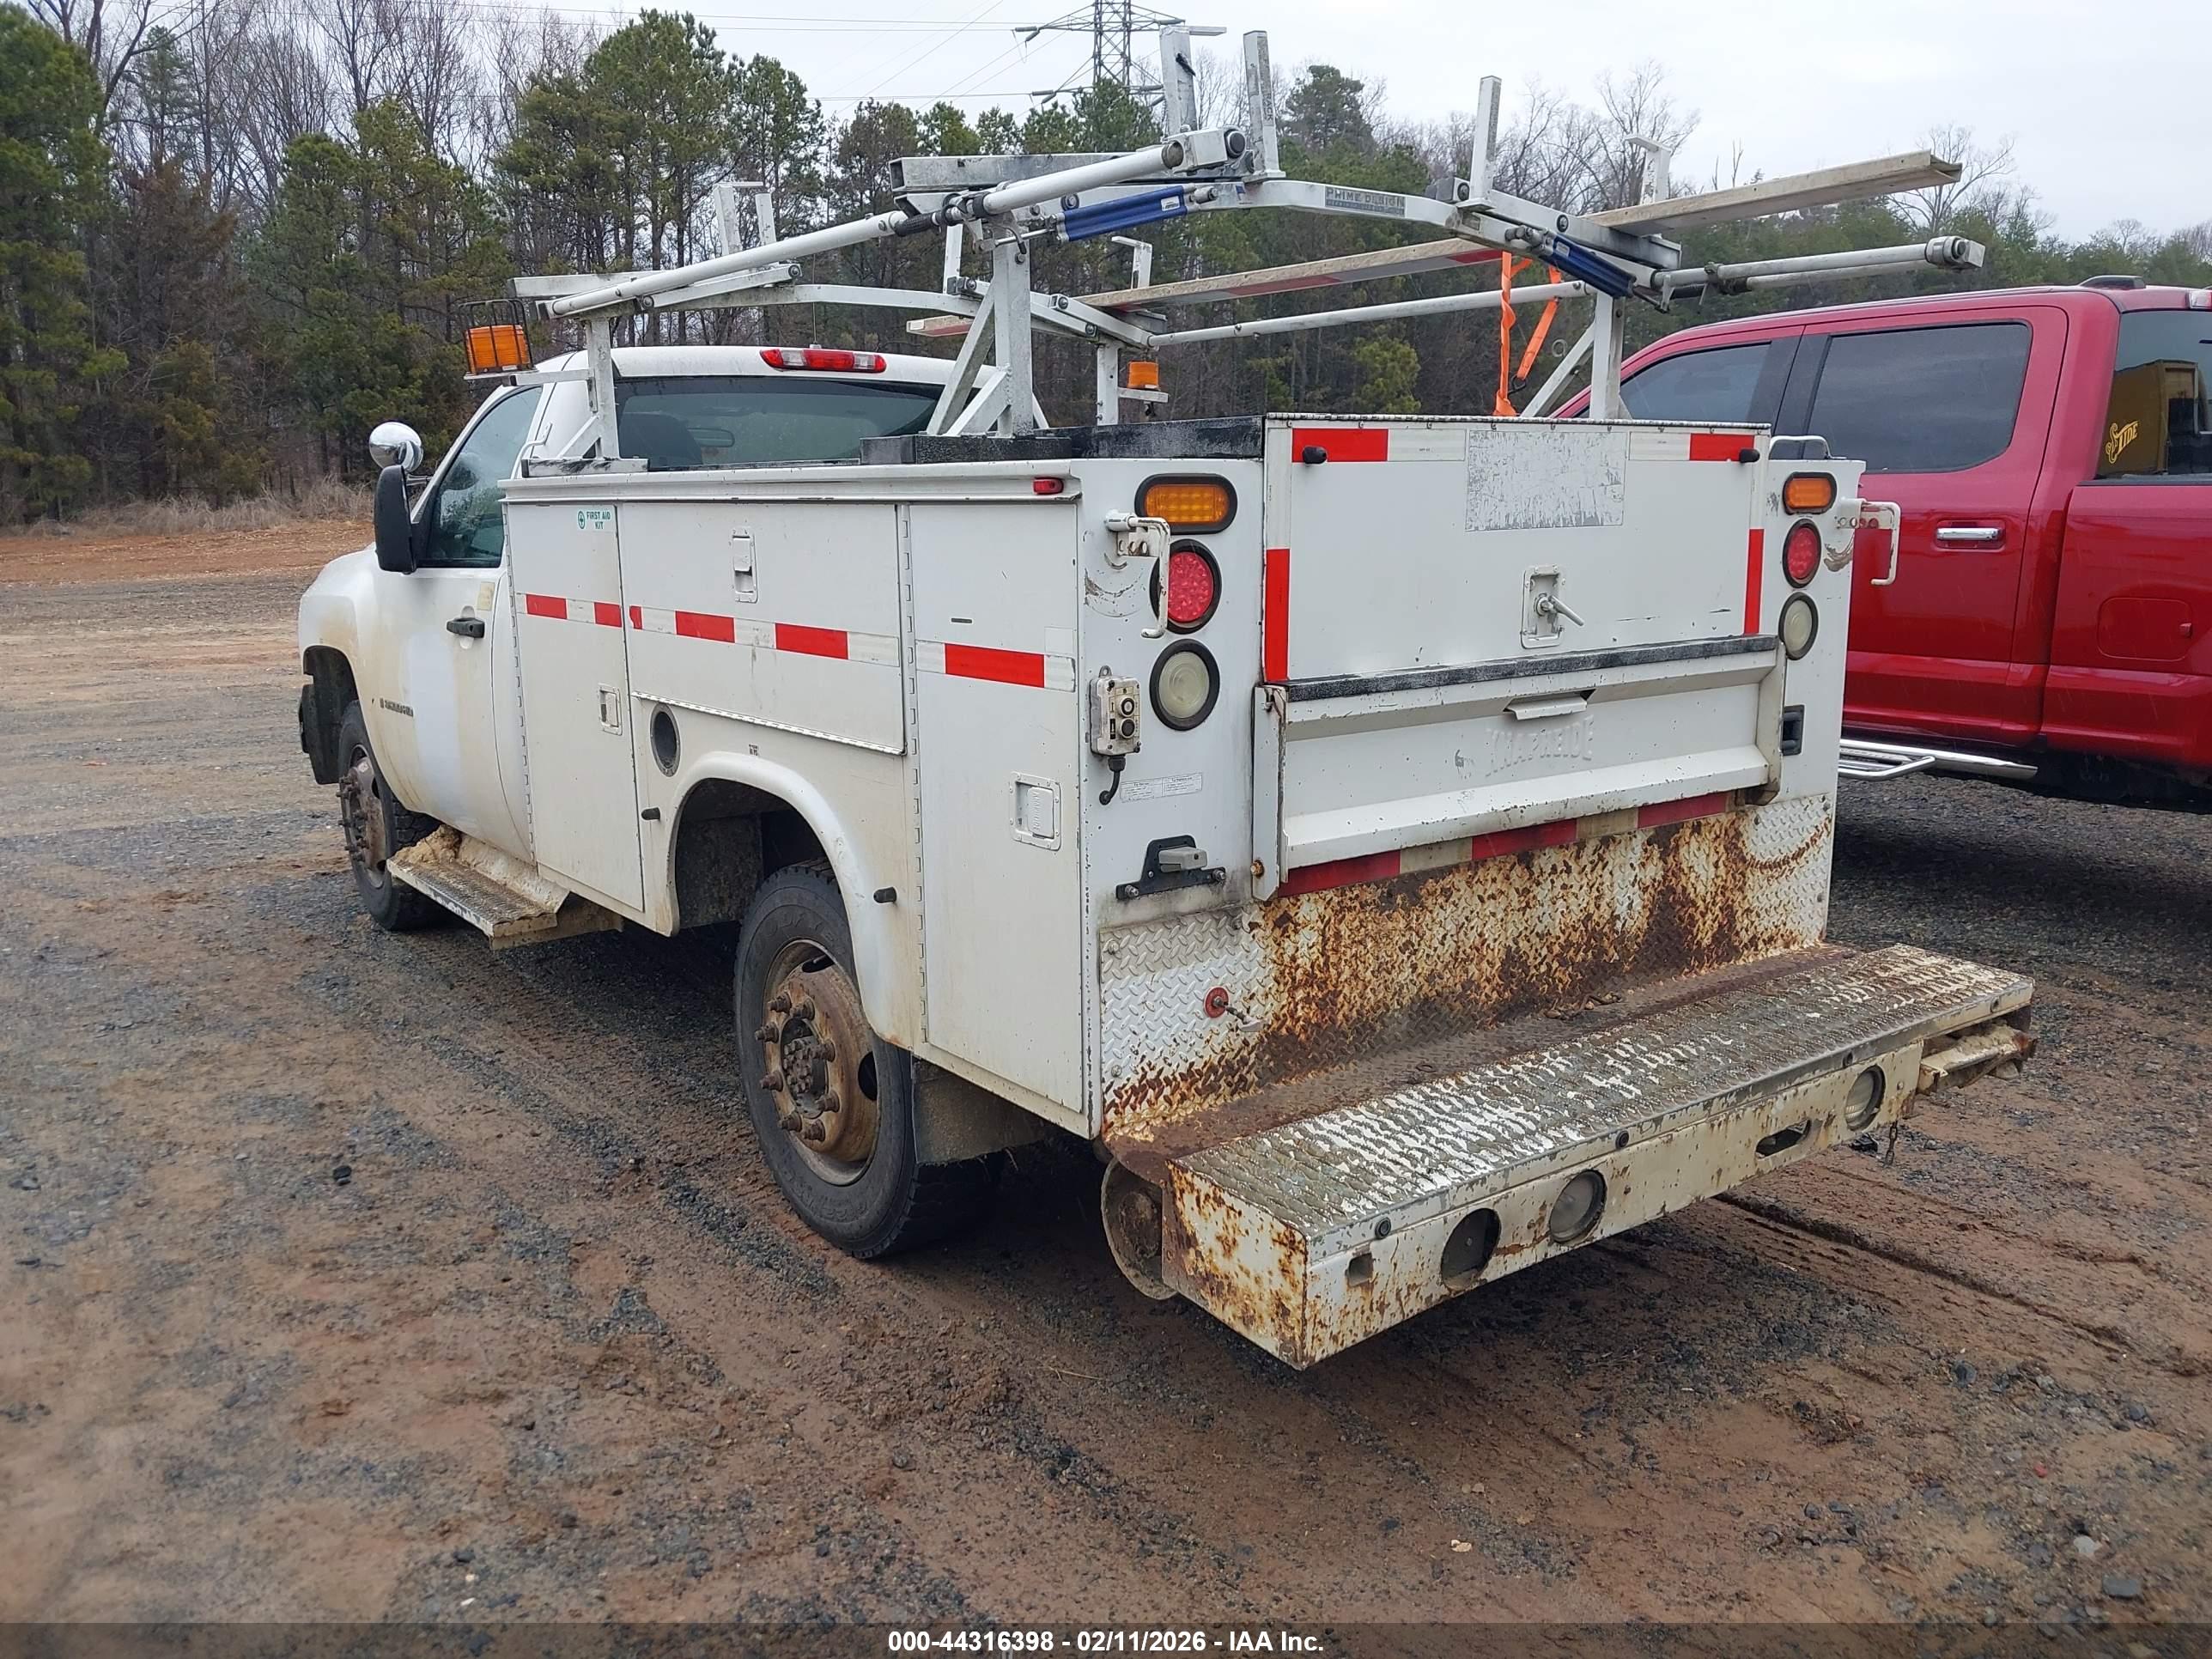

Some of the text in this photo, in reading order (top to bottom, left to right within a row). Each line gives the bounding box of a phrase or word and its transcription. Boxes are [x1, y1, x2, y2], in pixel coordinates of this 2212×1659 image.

[1326, 188, 1406, 207] PRIME DESIGN
[586, 511, 611, 520] FIRST AID
[594, 521, 604, 530] KIT
